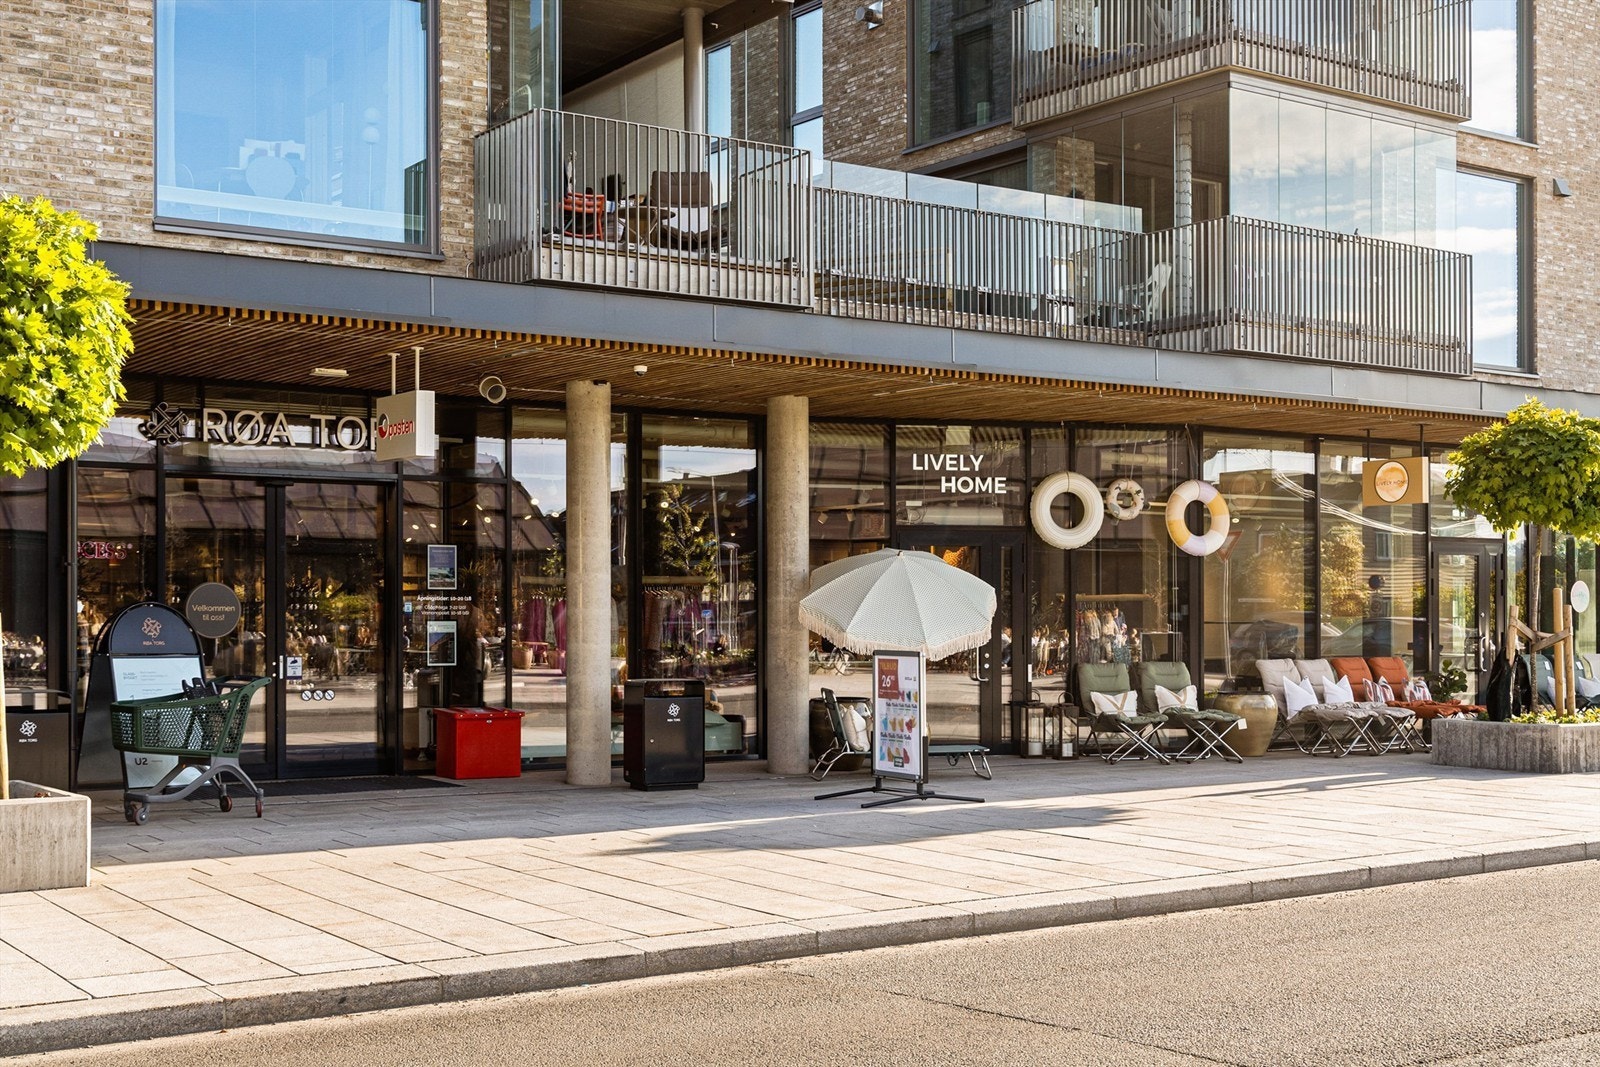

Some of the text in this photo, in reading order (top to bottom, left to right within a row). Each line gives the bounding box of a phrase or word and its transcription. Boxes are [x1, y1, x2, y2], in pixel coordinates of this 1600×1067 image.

[202, 407, 377, 450] RØA TO
[389, 419, 415, 440] posten
[912, 453, 984, 471] LIVELY
[941, 476, 1007, 494] HOME
[77, 541, 128, 560] CESS
[191, 604, 236, 613] Velkommen
[134, 757, 148, 766] U2
